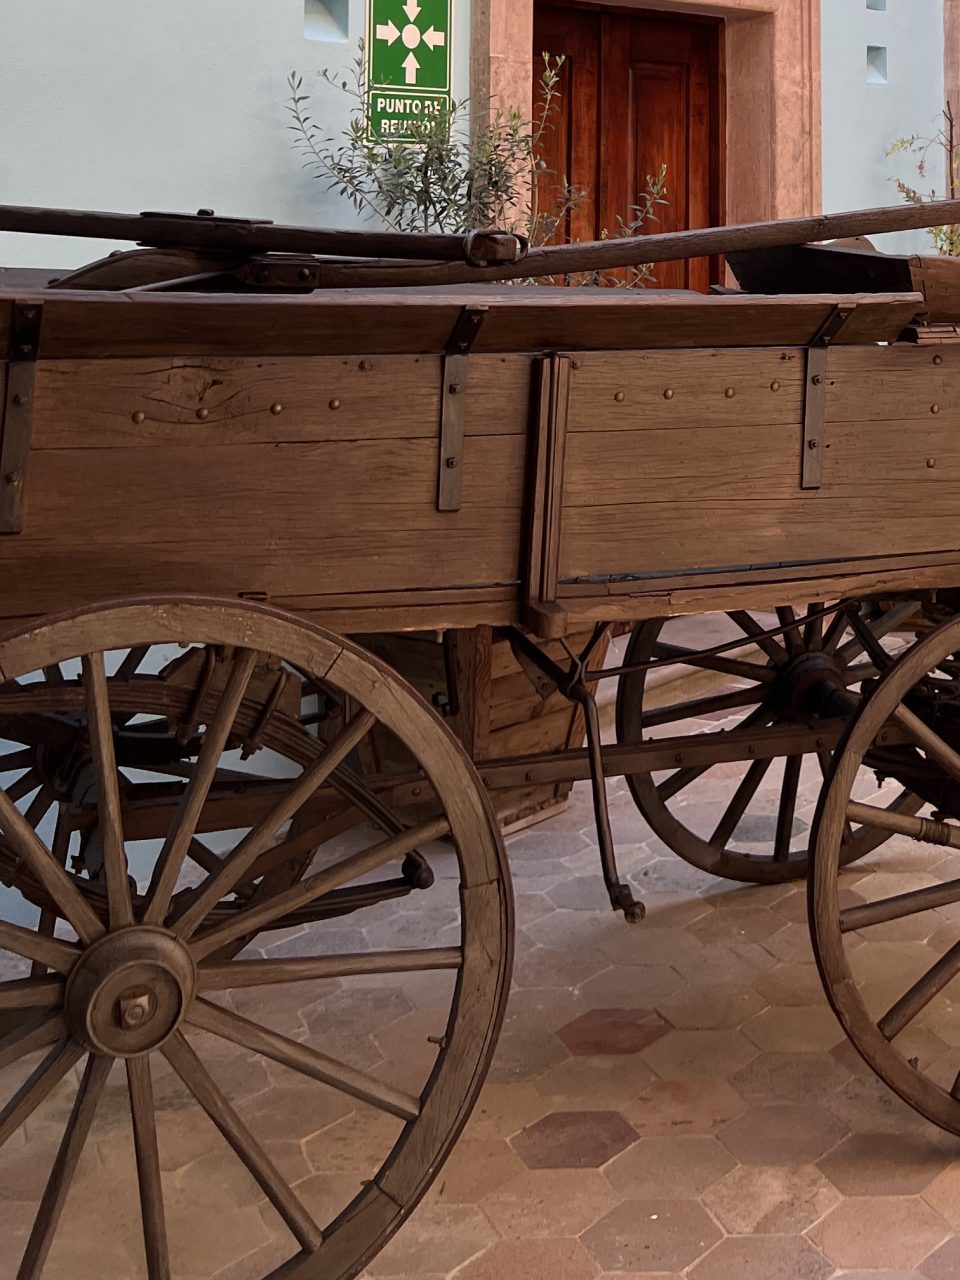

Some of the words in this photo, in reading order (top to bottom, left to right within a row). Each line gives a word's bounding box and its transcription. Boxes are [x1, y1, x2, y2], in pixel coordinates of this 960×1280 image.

[377, 98, 421, 114] PUNTO
[424, 100, 441, 115] DE
[381, 117, 438, 134] REUÓ
